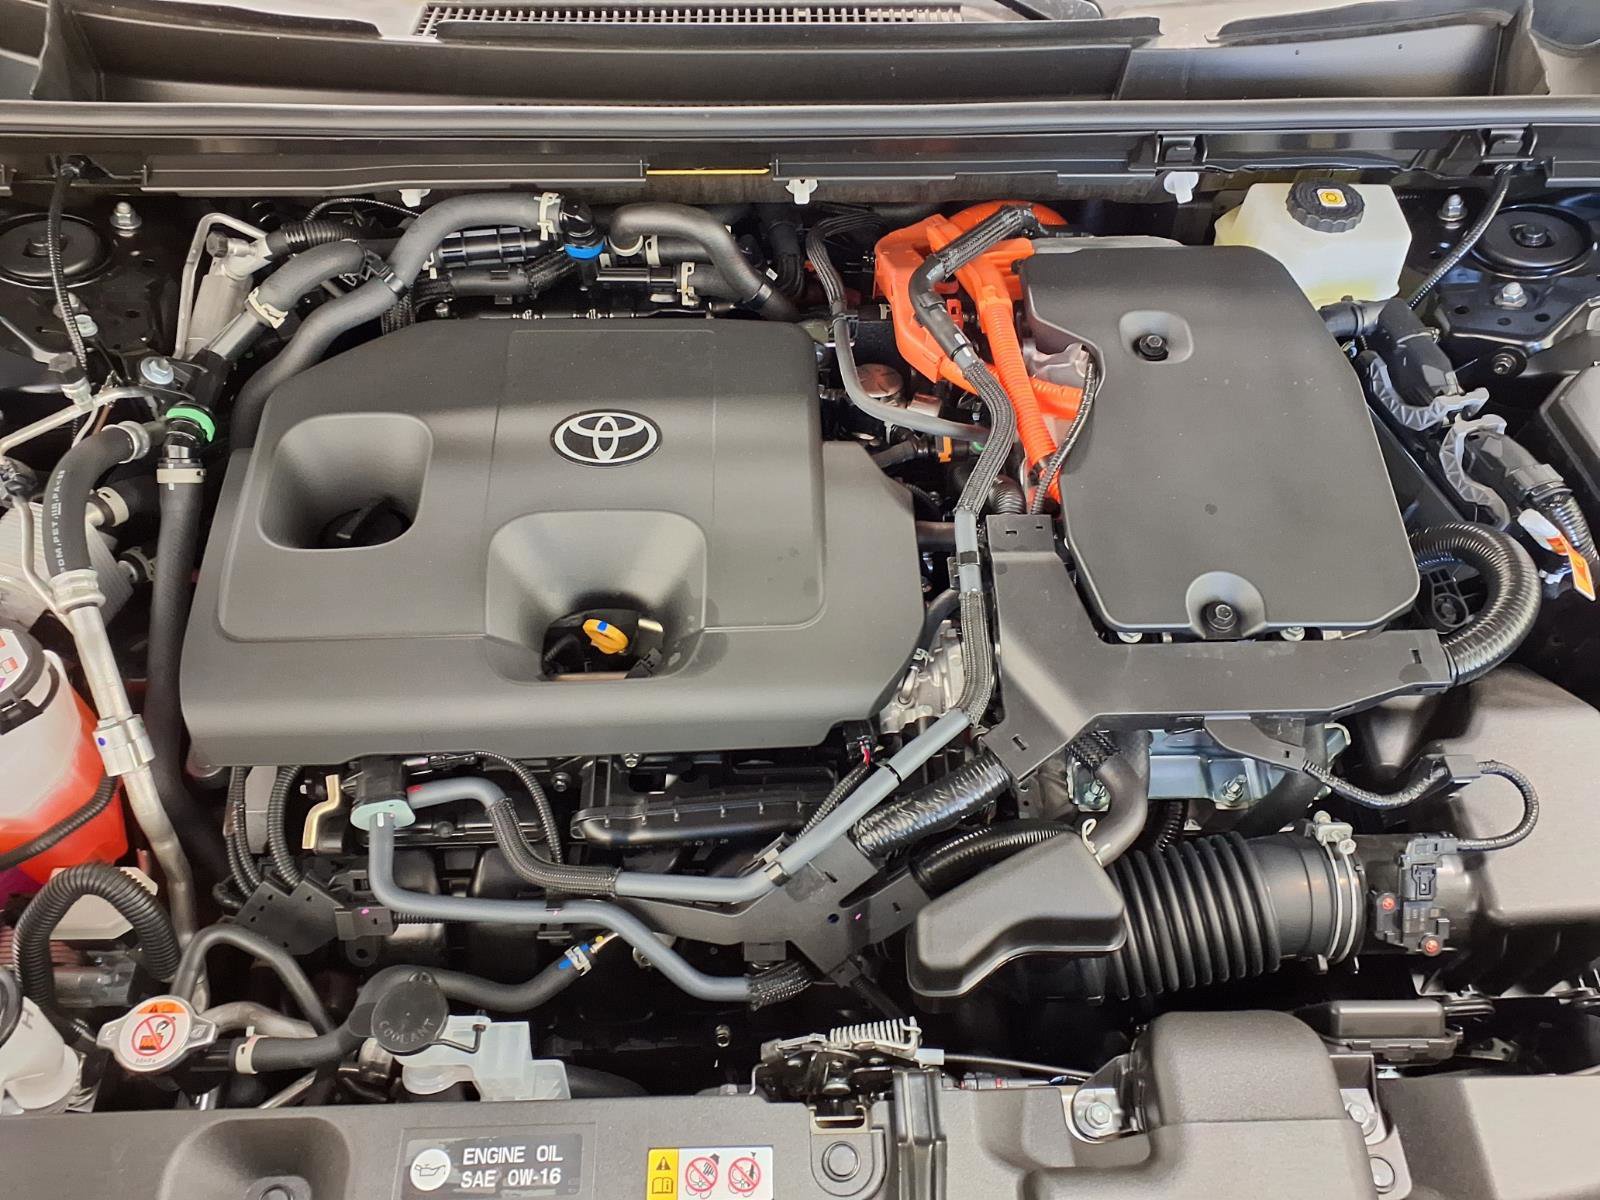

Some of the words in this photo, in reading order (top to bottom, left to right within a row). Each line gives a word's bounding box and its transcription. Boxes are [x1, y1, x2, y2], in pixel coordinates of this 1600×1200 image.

[379, 1017, 435, 1045] COOLANT
[462, 1146, 526, 1166] ENGINE
[536, 1145, 564, 1162] OIL
[460, 1169, 497, 1188] SAE
[507, 1167, 562, 1187] 0W-16
